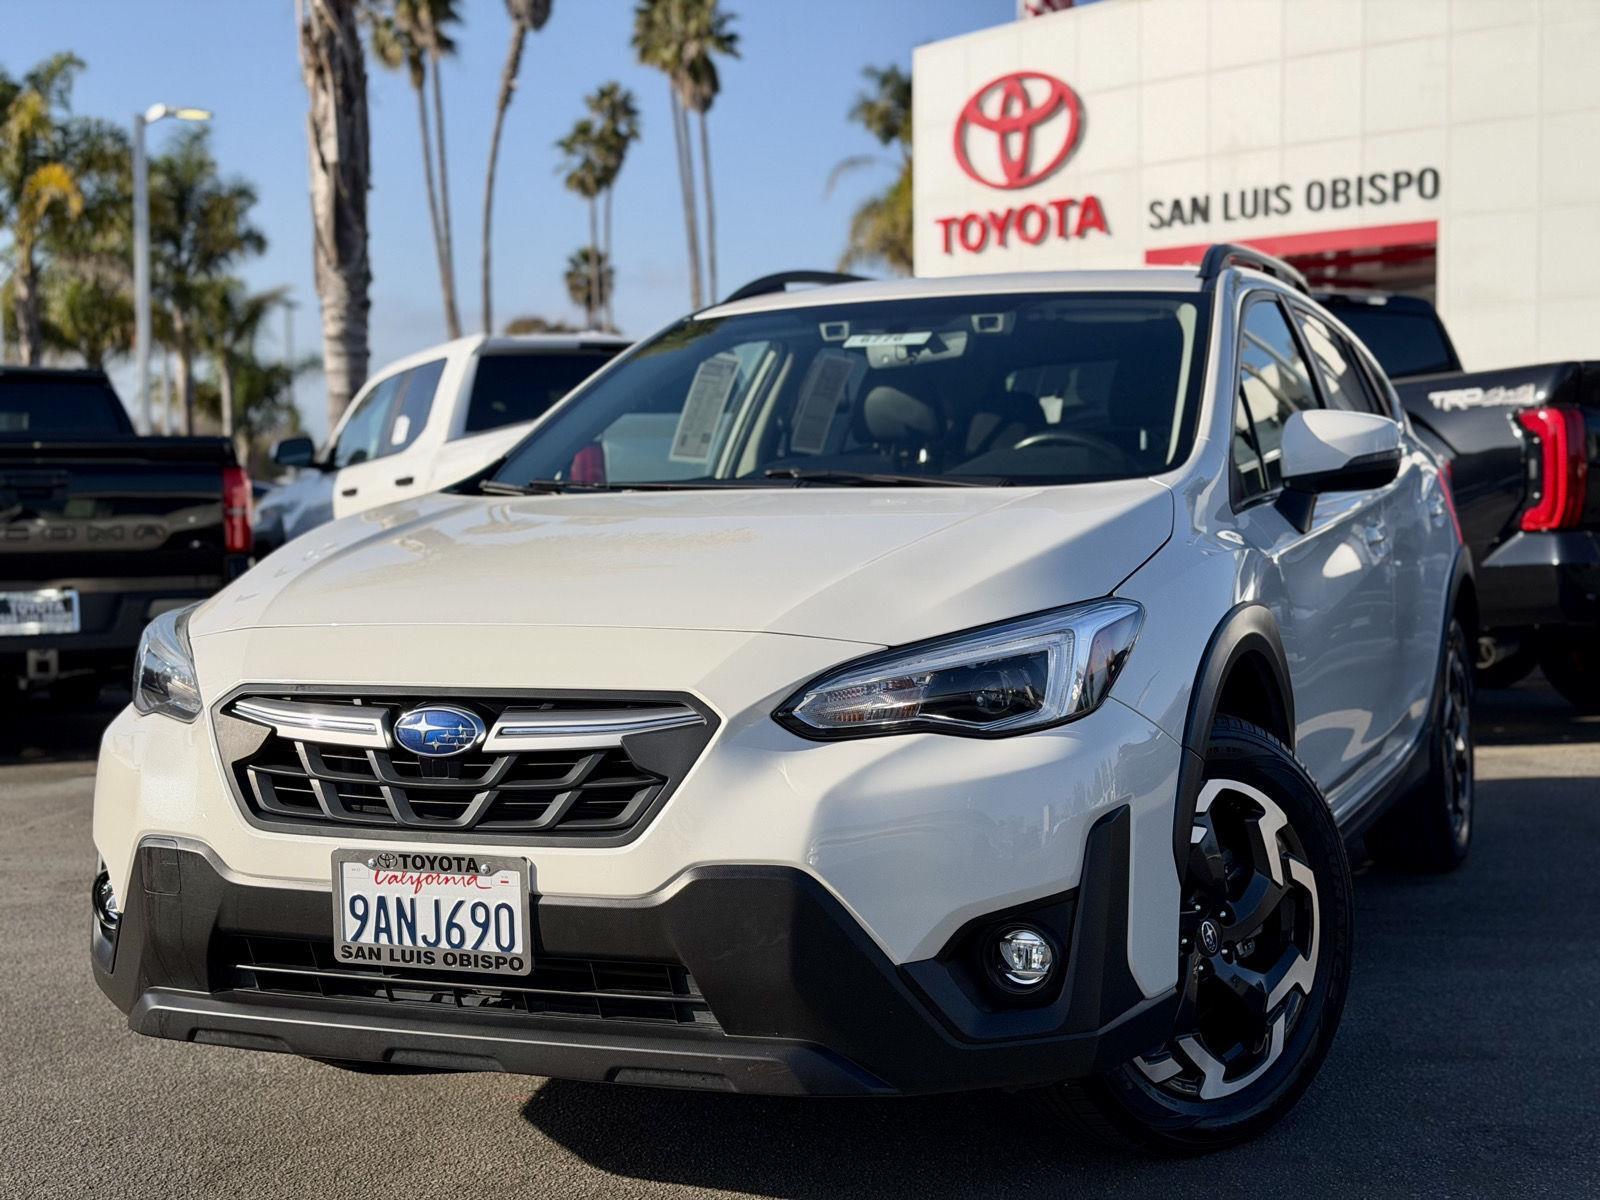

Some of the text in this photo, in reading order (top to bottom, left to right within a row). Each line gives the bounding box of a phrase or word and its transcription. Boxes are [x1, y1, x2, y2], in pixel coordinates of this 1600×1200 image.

[1149, 168, 1439, 230] SAN LUIS OBISPO
[936, 195, 1110, 255] TOYOTA
[374, 869, 492, 894] California
[399, 853, 480, 873] TOYOTA
[349, 894, 516, 953] 9ANJ690
[341, 944, 524, 972] SAN LUIS OBISPO
